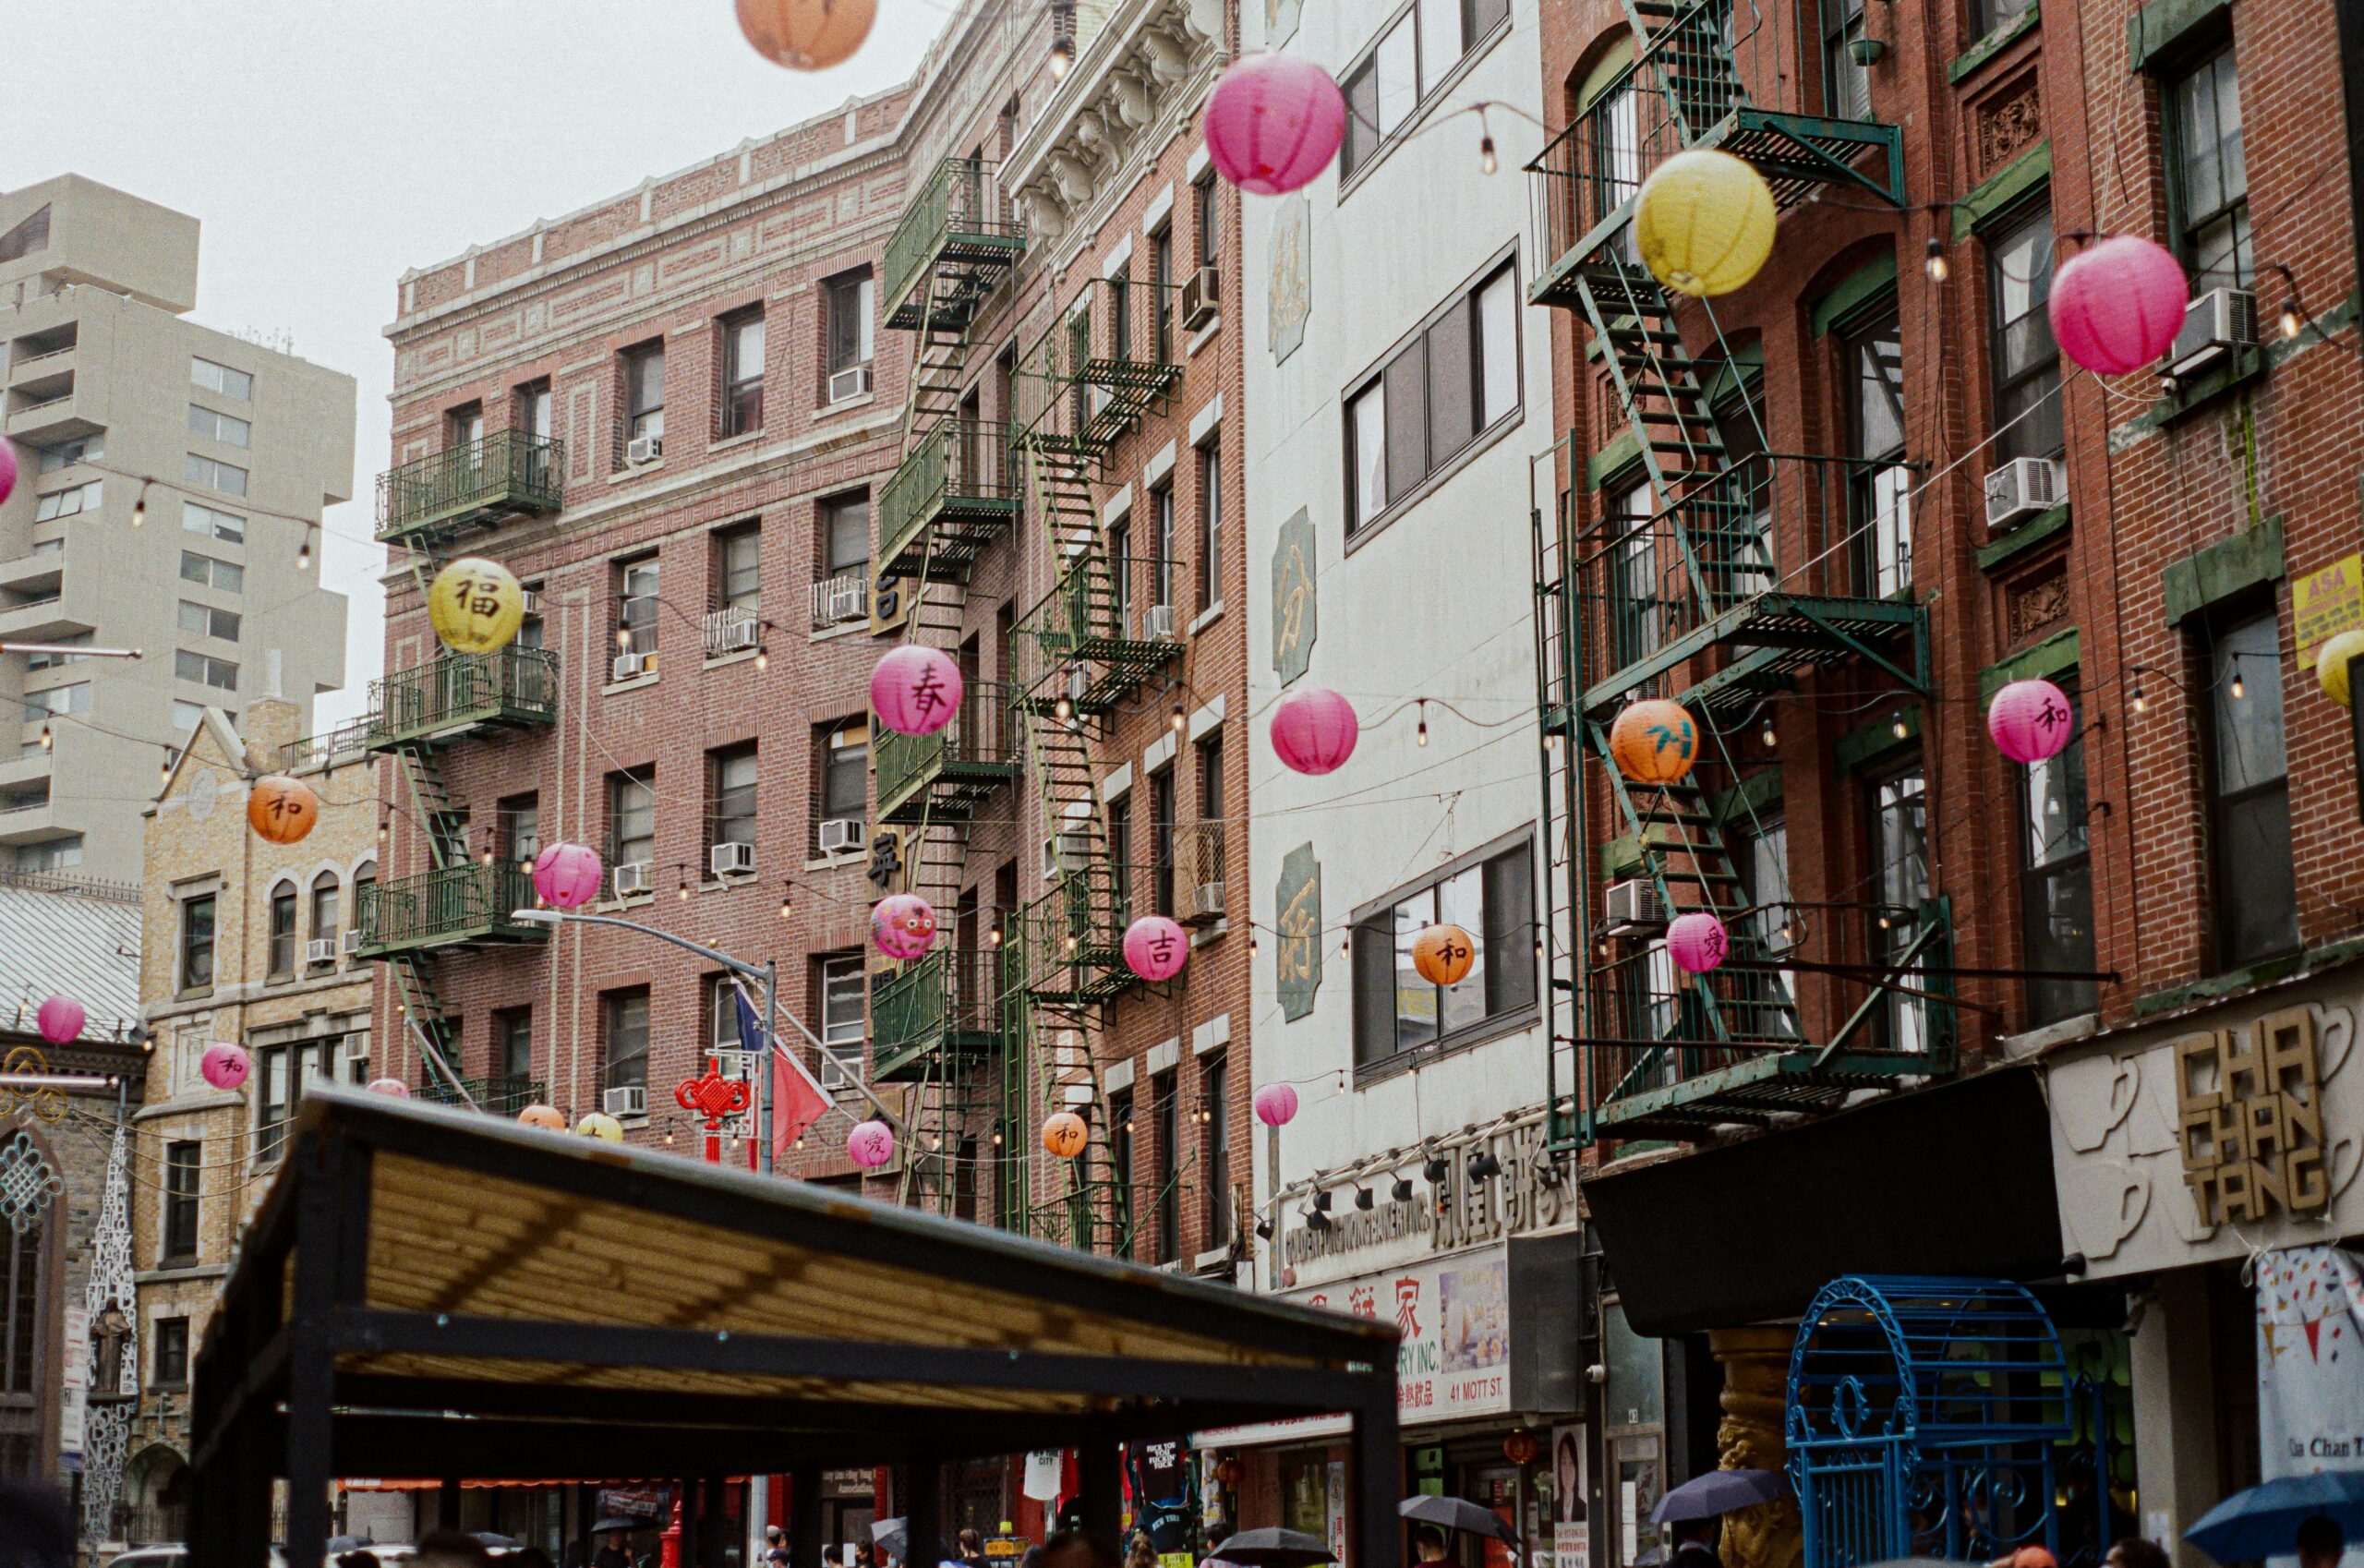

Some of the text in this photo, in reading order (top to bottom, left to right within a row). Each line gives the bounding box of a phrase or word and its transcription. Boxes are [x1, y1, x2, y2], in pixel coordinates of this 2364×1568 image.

[455, 569, 501, 619] 福
[2309, 565, 2346, 600] ASA
[911, 662, 947, 712] 春
[2033, 696, 2068, 734] 和
[266, 790, 303, 821] 和
[1147, 928, 1177, 963] 吉
[1435, 937, 1467, 967] 和
[218, 1054, 243, 1073] 和
[2176, 1008, 2319, 1113] CHA
[1055, 1122, 1079, 1144] 和
[2179, 1082, 2327, 1172] CHAN
[2185, 1142, 2329, 1225] TANG
[1417, 1340, 1440, 1374] INC.
[1450, 1377, 1503, 1403] 41 MOTT ST.
[1039, 1457, 1054, 1465] CITY
[2310, 1436, 2350, 1458] Chan
[1152, 1514, 1180, 1532] NEW YORK
